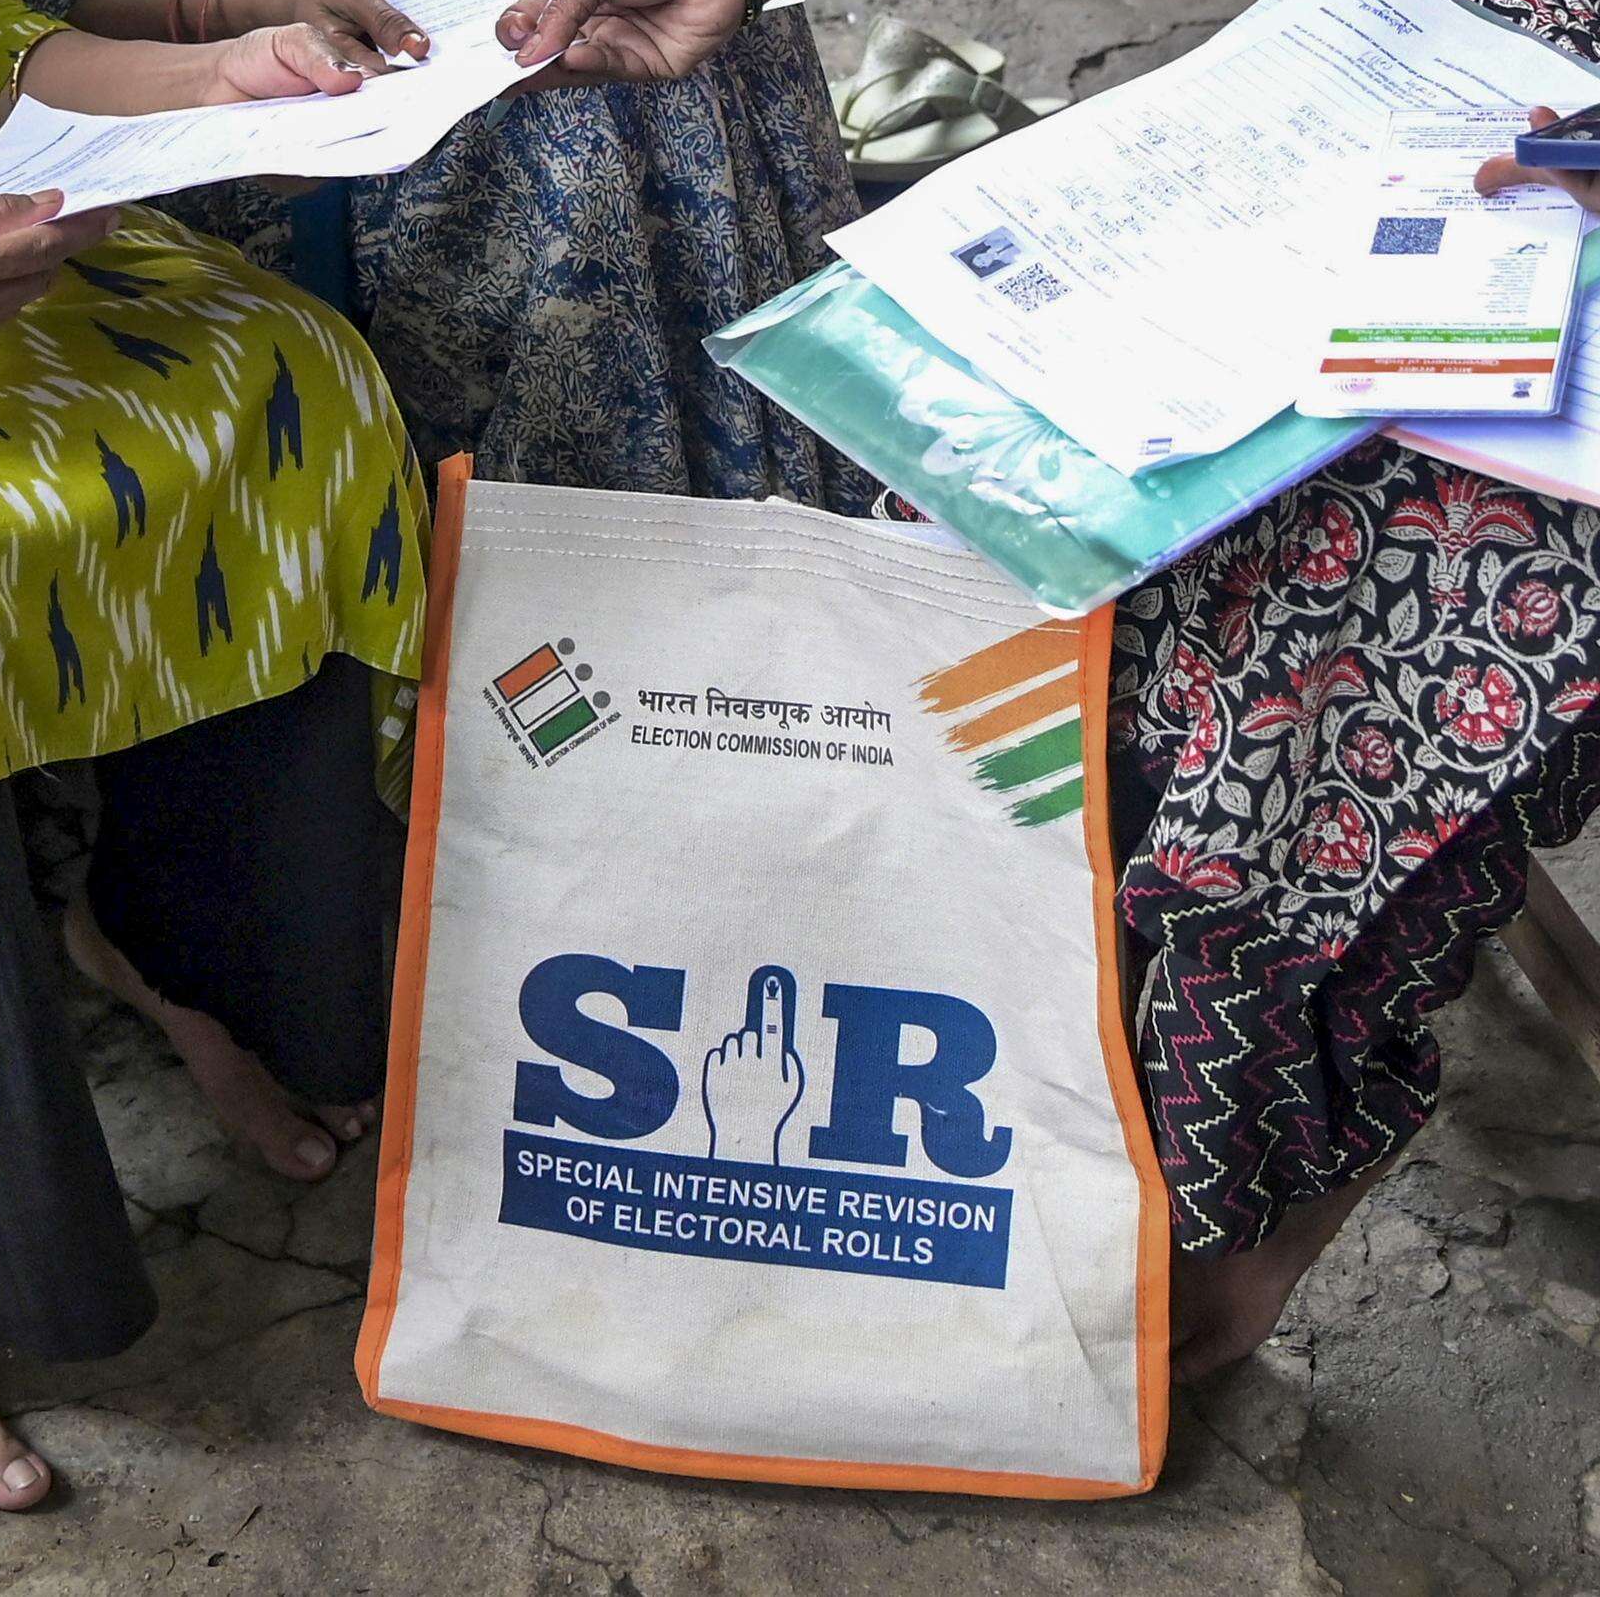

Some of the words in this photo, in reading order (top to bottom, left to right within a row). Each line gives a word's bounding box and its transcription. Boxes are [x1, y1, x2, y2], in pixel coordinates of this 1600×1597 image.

[638, 688, 697, 717] भारत
[705, 687, 813, 729] निवडणूक
[820, 701, 892, 734] आयोग
[544, 747, 570, 768] ELECTION
[631, 724, 712, 751] ELECTION
[716, 731, 822, 761] COMMISSION
[825, 738, 848, 762] OF
[851, 740, 894, 767] INDIA
[516, 1150, 644, 1196] SPECIAL
[653, 1172, 827, 1215] INTENSIVE
[837, 1191, 996, 1233] REVISION
[566, 1196, 603, 1226] OF
[612, 1207, 812, 1253] ELECTORAL
[821, 1226, 934, 1265] ROLLS
